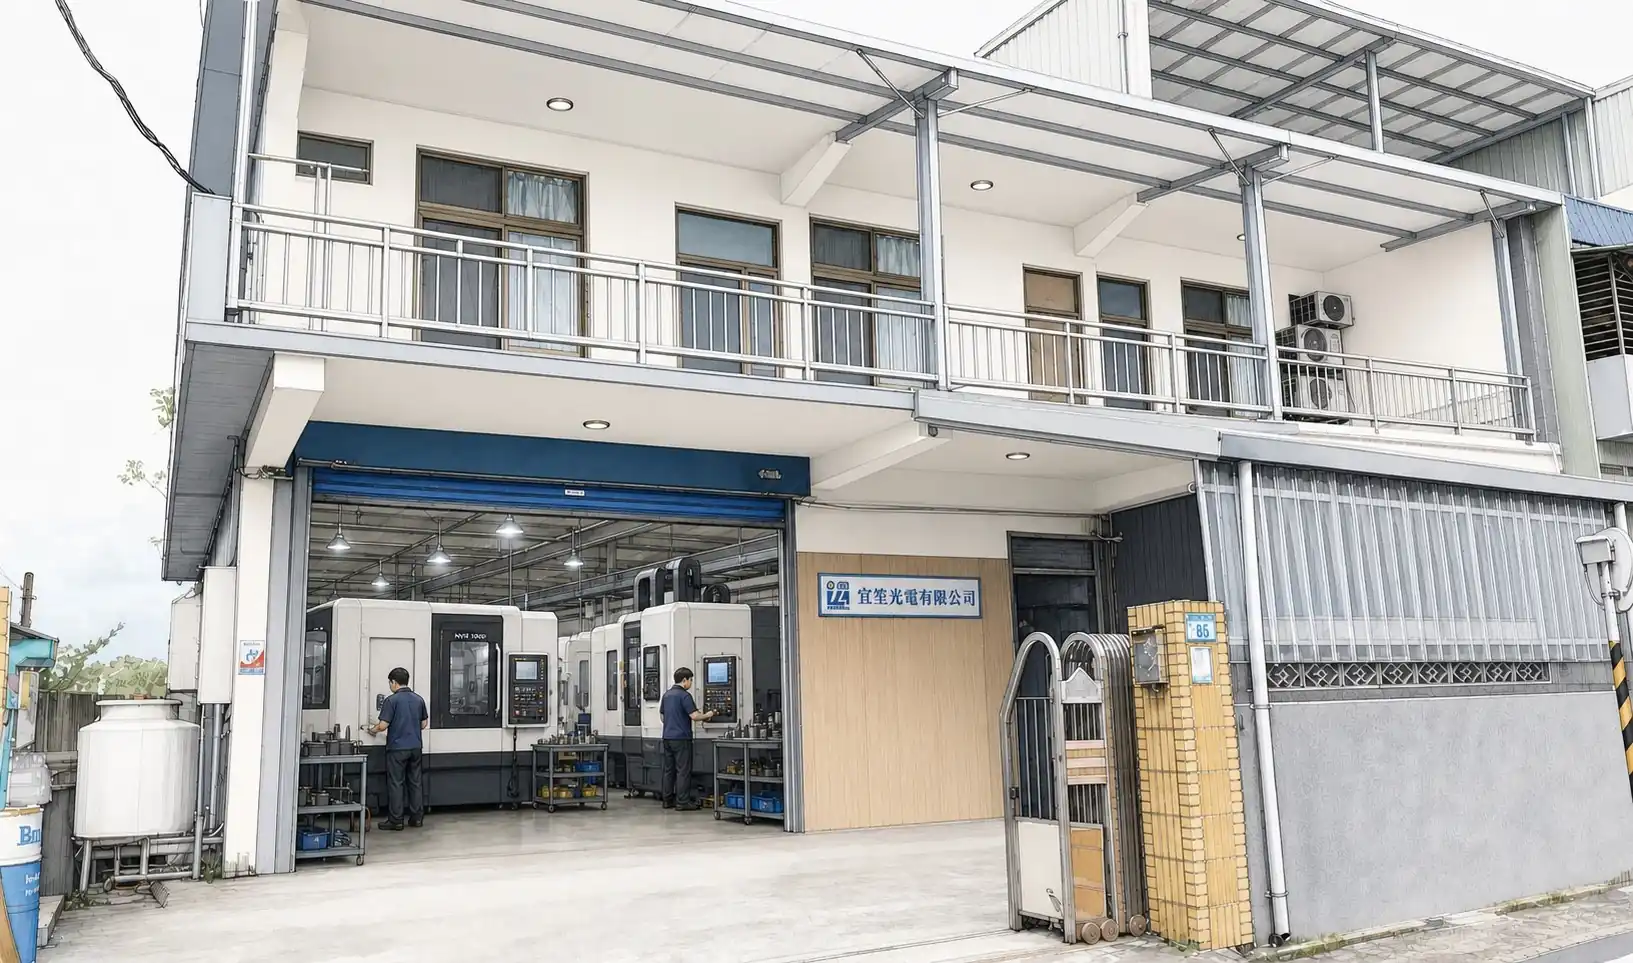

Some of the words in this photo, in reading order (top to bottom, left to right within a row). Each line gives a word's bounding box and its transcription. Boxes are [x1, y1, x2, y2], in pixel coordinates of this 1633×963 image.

[857, 587, 975, 606] 宜笙光電有限公司
